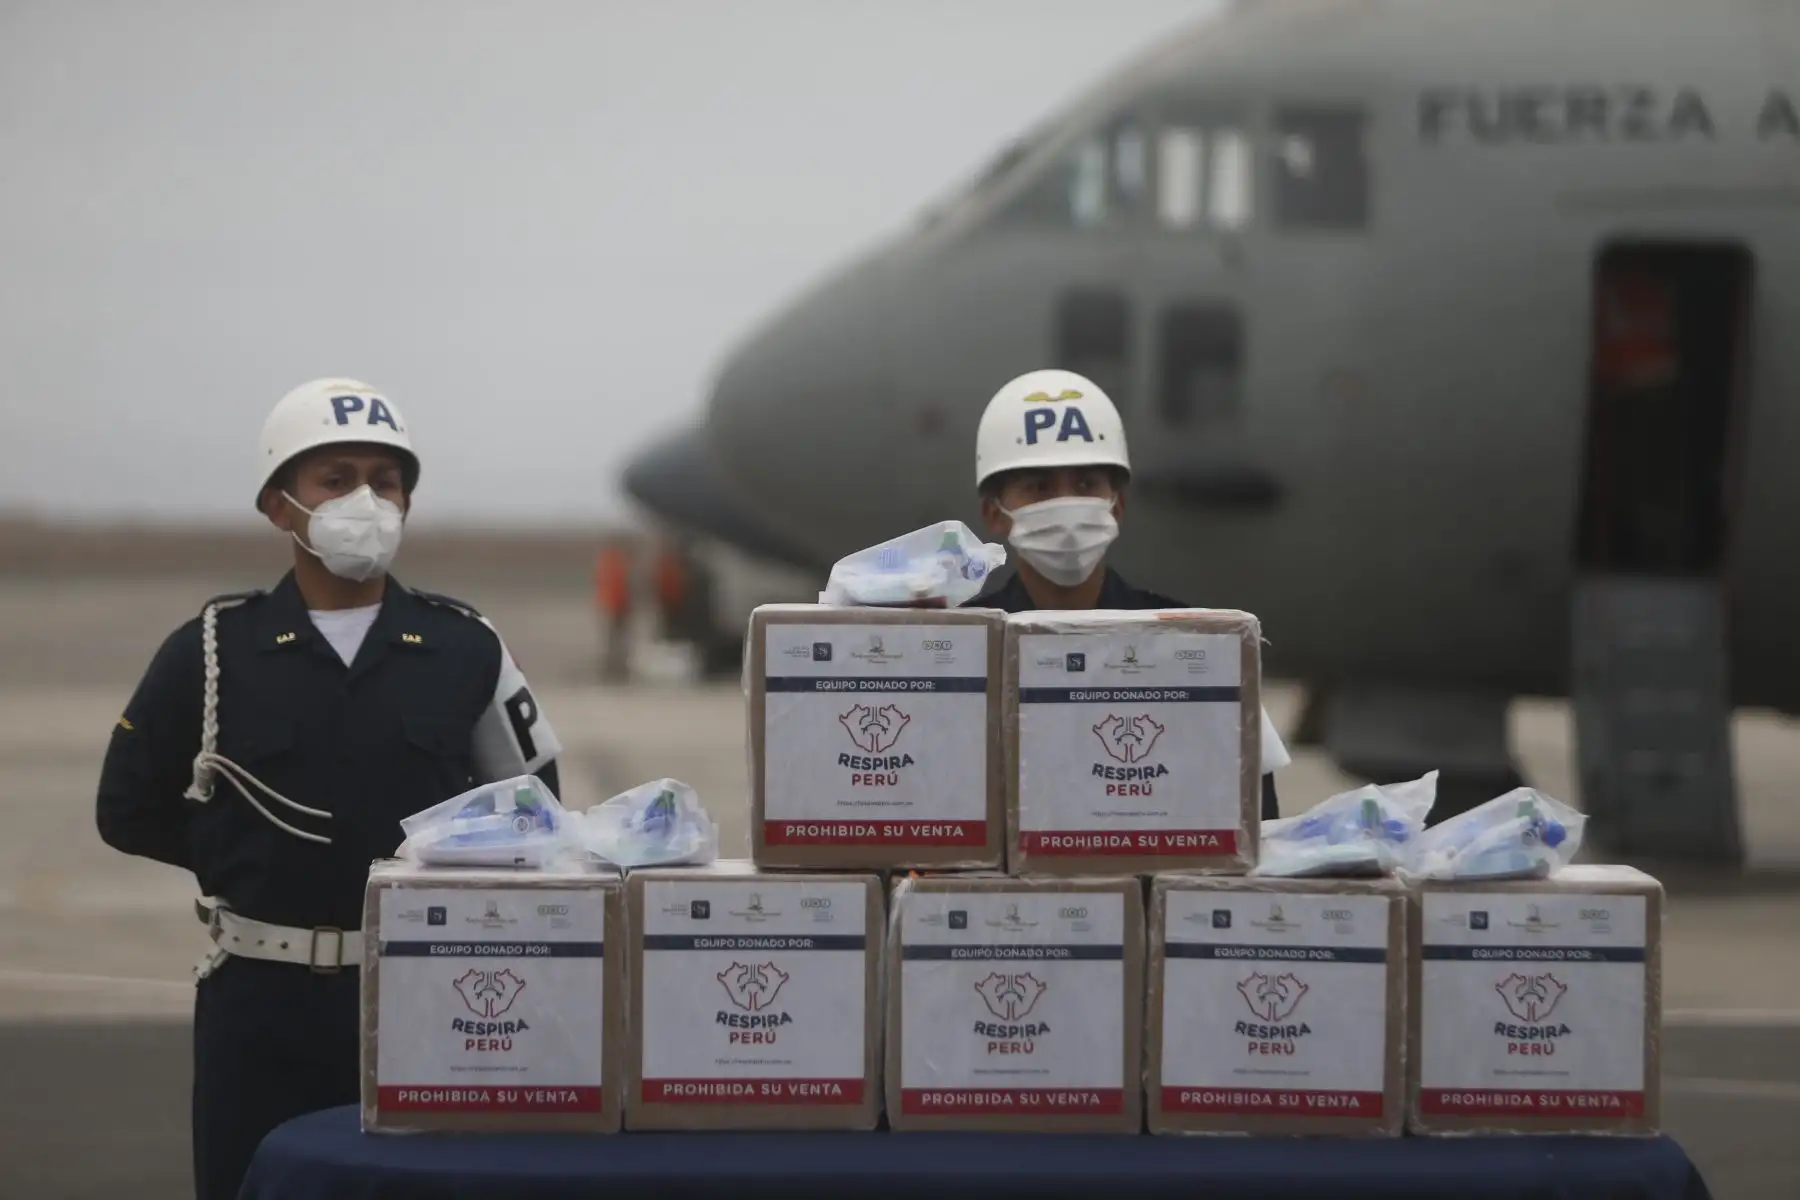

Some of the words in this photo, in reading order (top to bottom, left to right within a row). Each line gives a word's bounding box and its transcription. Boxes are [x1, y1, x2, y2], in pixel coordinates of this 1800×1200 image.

[1417, 85, 1714, 145] FUERZA
[330, 395, 398, 432] PA
[1023, 406, 1093, 445] PA
[816, 681, 856, 690] EQUIPO
[860, 681, 907, 690] DONADO
[1070, 691, 1110, 700] EQUIPO
[1113, 691, 1161, 700] DONADO
[504, 686, 538, 763] P
[838, 753, 914, 770] RESPIRA
[852, 771, 898, 786] PERÚ
[1092, 764, 1169, 781] RESPIRA
[1106, 781, 1152, 796] PERÚ
[786, 825, 876, 837] PROHIBIDA
[883, 825, 904, 837] SU
[911, 825, 964, 837] VENTA
[1041, 836, 1131, 847] PROHIBIDA
[1138, 836, 1159, 847] SU
[1166, 835, 1218, 846] VENTA
[430, 945, 472, 954] EQUIPO
[475, 945, 523, 954] DONADO
[694, 939, 735, 948] EQUIPO
[738, 939, 786, 948] DONADO
[951, 948, 993, 958] EQUIPO
[995, 948, 1043, 958] DONADO
[1214, 948, 1255, 957] EQUIPO
[1258, 948, 1307, 958] DONADO
[1472, 949, 1513, 958] EQUIPO
[1516, 949, 1564, 959] DONADO
[452, 1018, 530, 1036] RESPIRA
[716, 1011, 793, 1028] RESPIRA
[729, 1028, 776, 1044] PERÚ
[974, 1021, 1051, 1038] RESPIRA
[1234, 1020, 1312, 1039] RESPIRA
[1494, 1022, 1572, 1039] RESPIRA
[465, 1036, 513, 1052] PERÚ
[988, 1038, 1034, 1054] PERÚ
[1248, 1039, 1295, 1055] PERÚ
[1508, 1039, 1555, 1055] PERÚ
[398, 1091, 490, 1103] PROHIBIDA
[497, 1091, 518, 1103] SU
[526, 1091, 578, 1103] VENTA
[664, 1084, 754, 1095] PROHIBIDA
[761, 1084, 782, 1095] SU
[789, 1084, 842, 1095] VENTA
[922, 1093, 1013, 1105] PROHIBIDA
[1020, 1093, 1040, 1105] SU
[1048, 1093, 1100, 1105] VENTA
[1181, 1092, 1272, 1105] PROHIBIDA
[1279, 1094, 1299, 1106] SU
[1307, 1094, 1360, 1107] VENTA
[1441, 1094, 1533, 1106] PROHIBIDA
[1540, 1094, 1560, 1106] SU
[1568, 1094, 1621, 1106] VENTA
